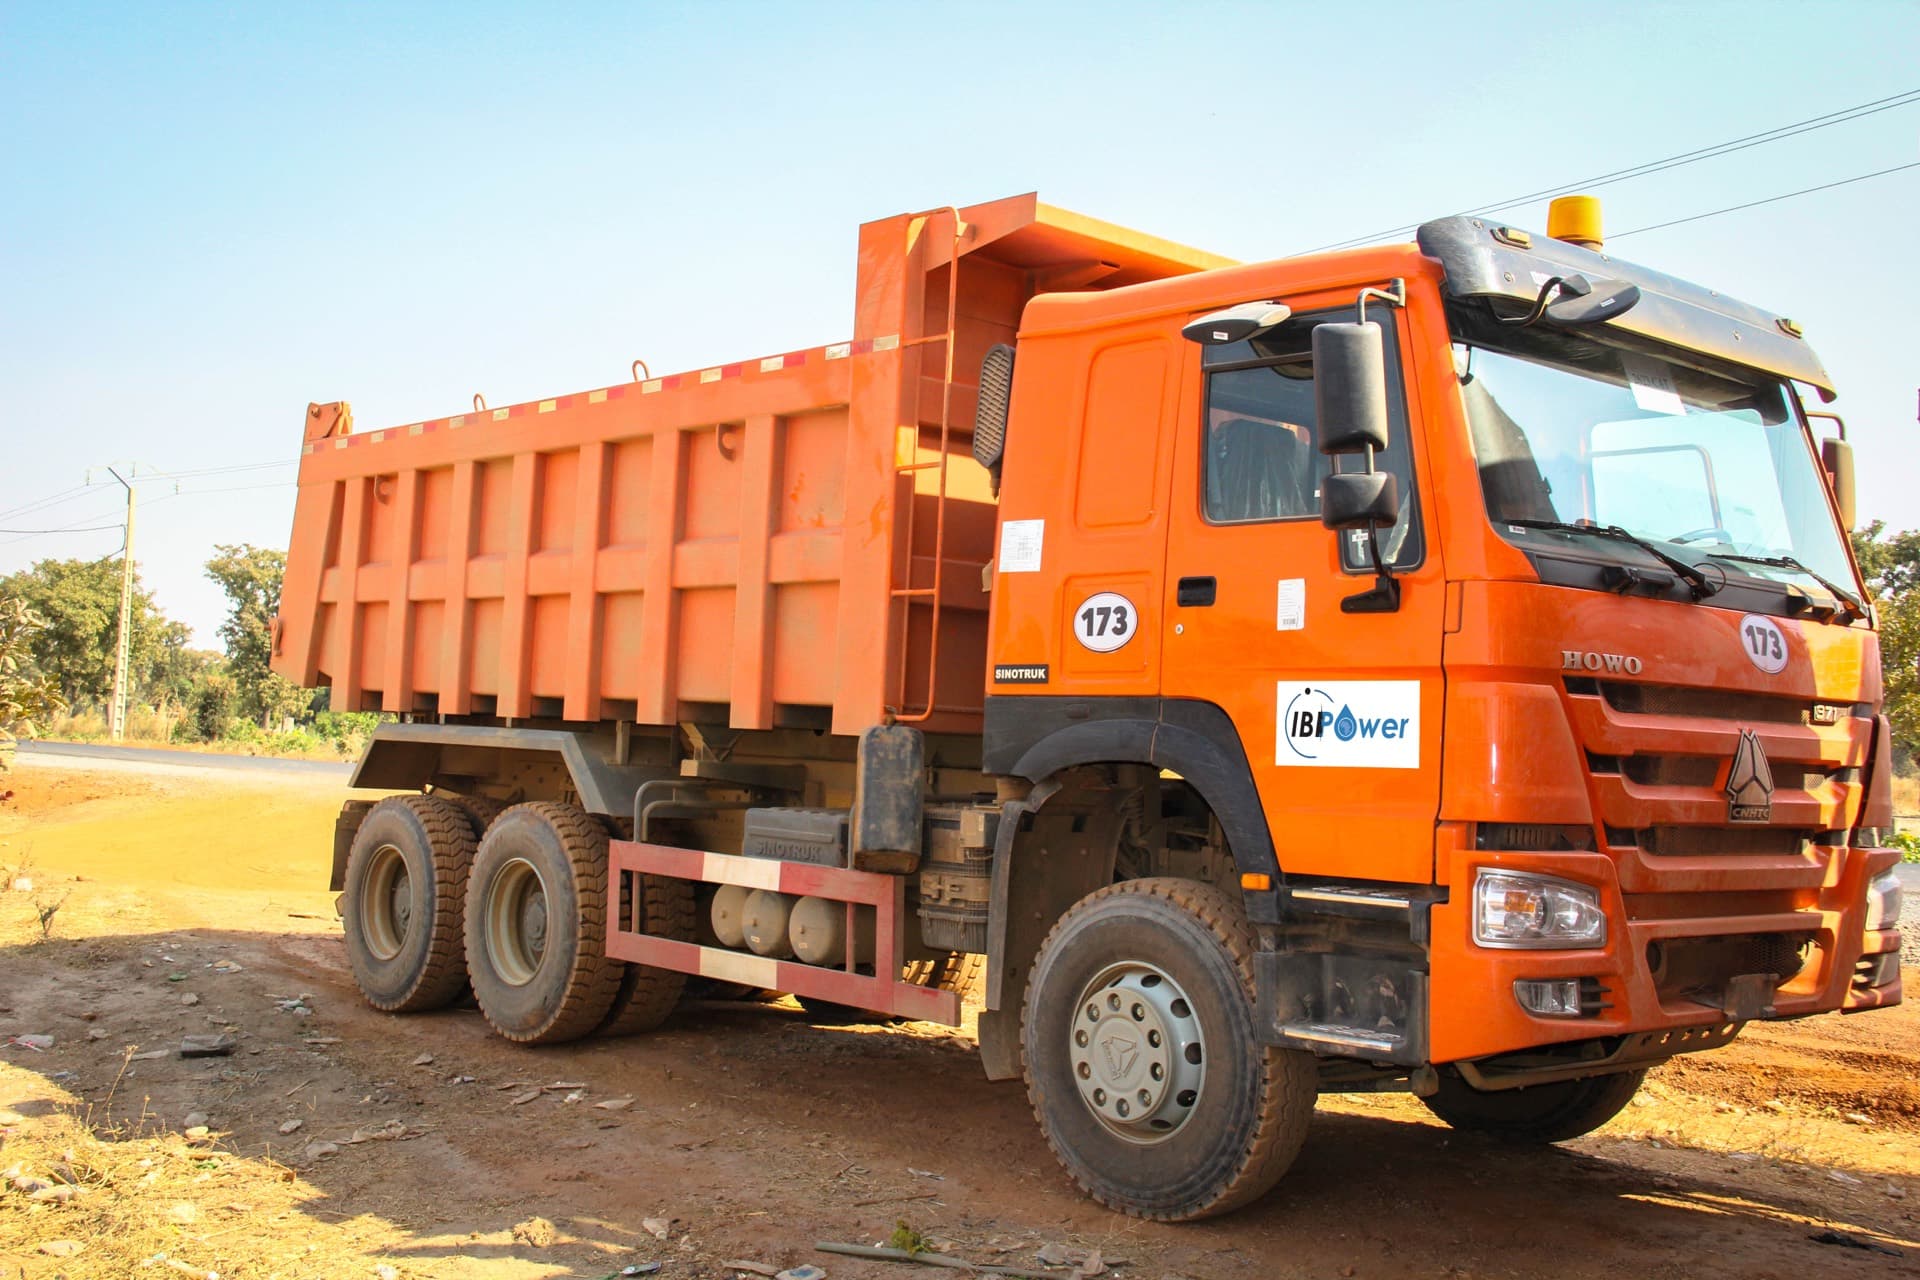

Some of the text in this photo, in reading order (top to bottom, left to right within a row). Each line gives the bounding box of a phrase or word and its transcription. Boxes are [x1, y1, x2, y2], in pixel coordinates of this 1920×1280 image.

[1081, 605, 1129, 637] 173
[1745, 624, 1783, 660] 173
[995, 668, 1047, 680] SINOTRUK
[1562, 650, 1642, 674] HOWO
